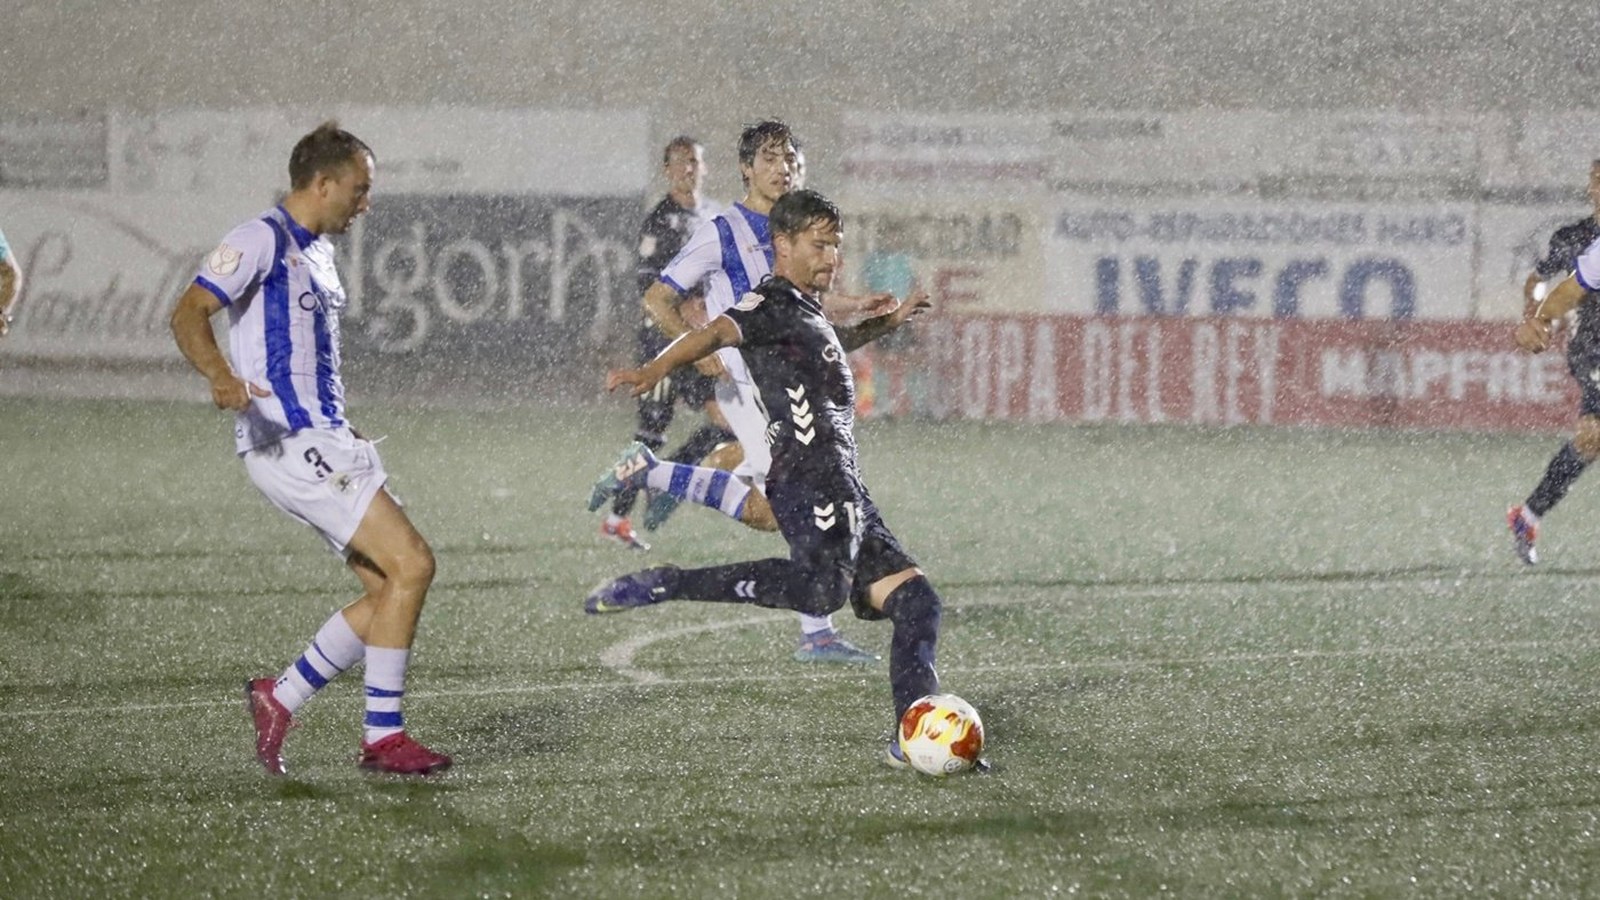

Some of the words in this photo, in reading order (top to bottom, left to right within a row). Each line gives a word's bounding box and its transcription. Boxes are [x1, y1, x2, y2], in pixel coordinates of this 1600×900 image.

[1096, 256, 1417, 319] IVECO
[1084, 322, 1168, 422] DEL
[1193, 324, 1280, 425] REY
[1320, 350, 1567, 402] MAPFRE
